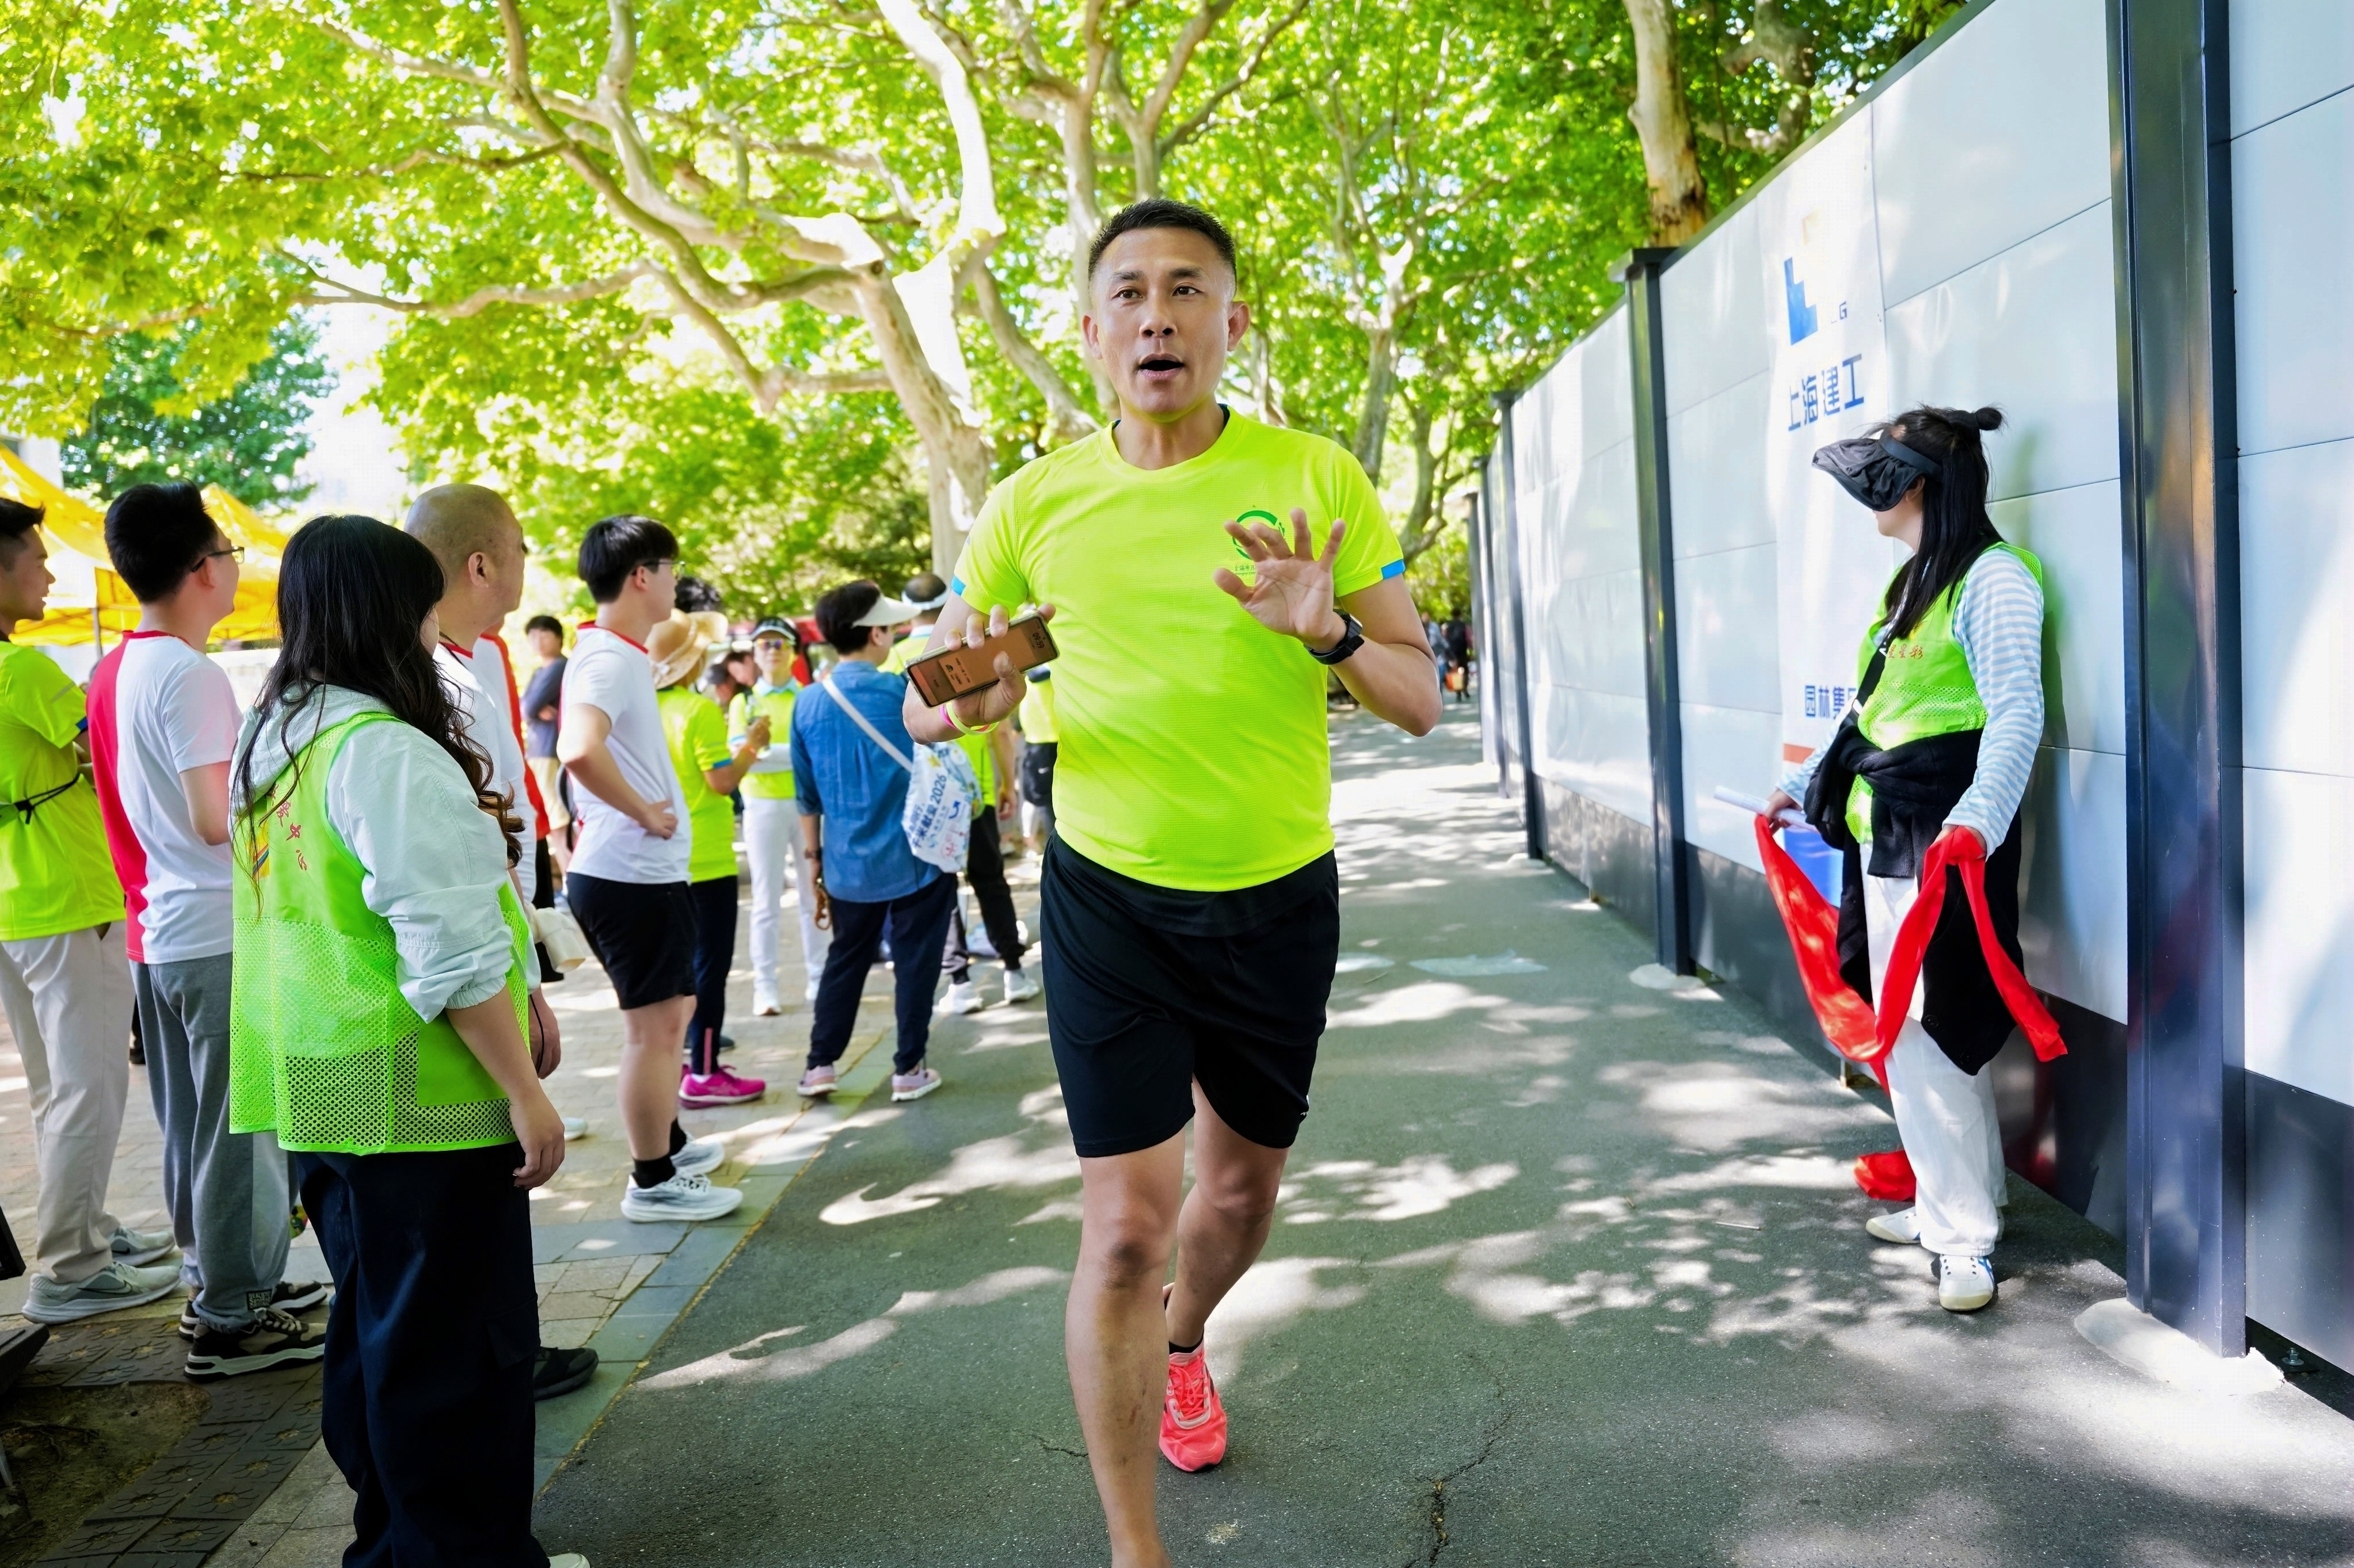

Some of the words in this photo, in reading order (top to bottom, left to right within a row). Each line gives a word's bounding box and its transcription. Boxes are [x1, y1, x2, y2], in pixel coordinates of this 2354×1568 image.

[1788, 353, 1864, 432] 上海建工
[1033, 632, 1045, 648] 09:59
[930, 773, 947, 804] 2026
